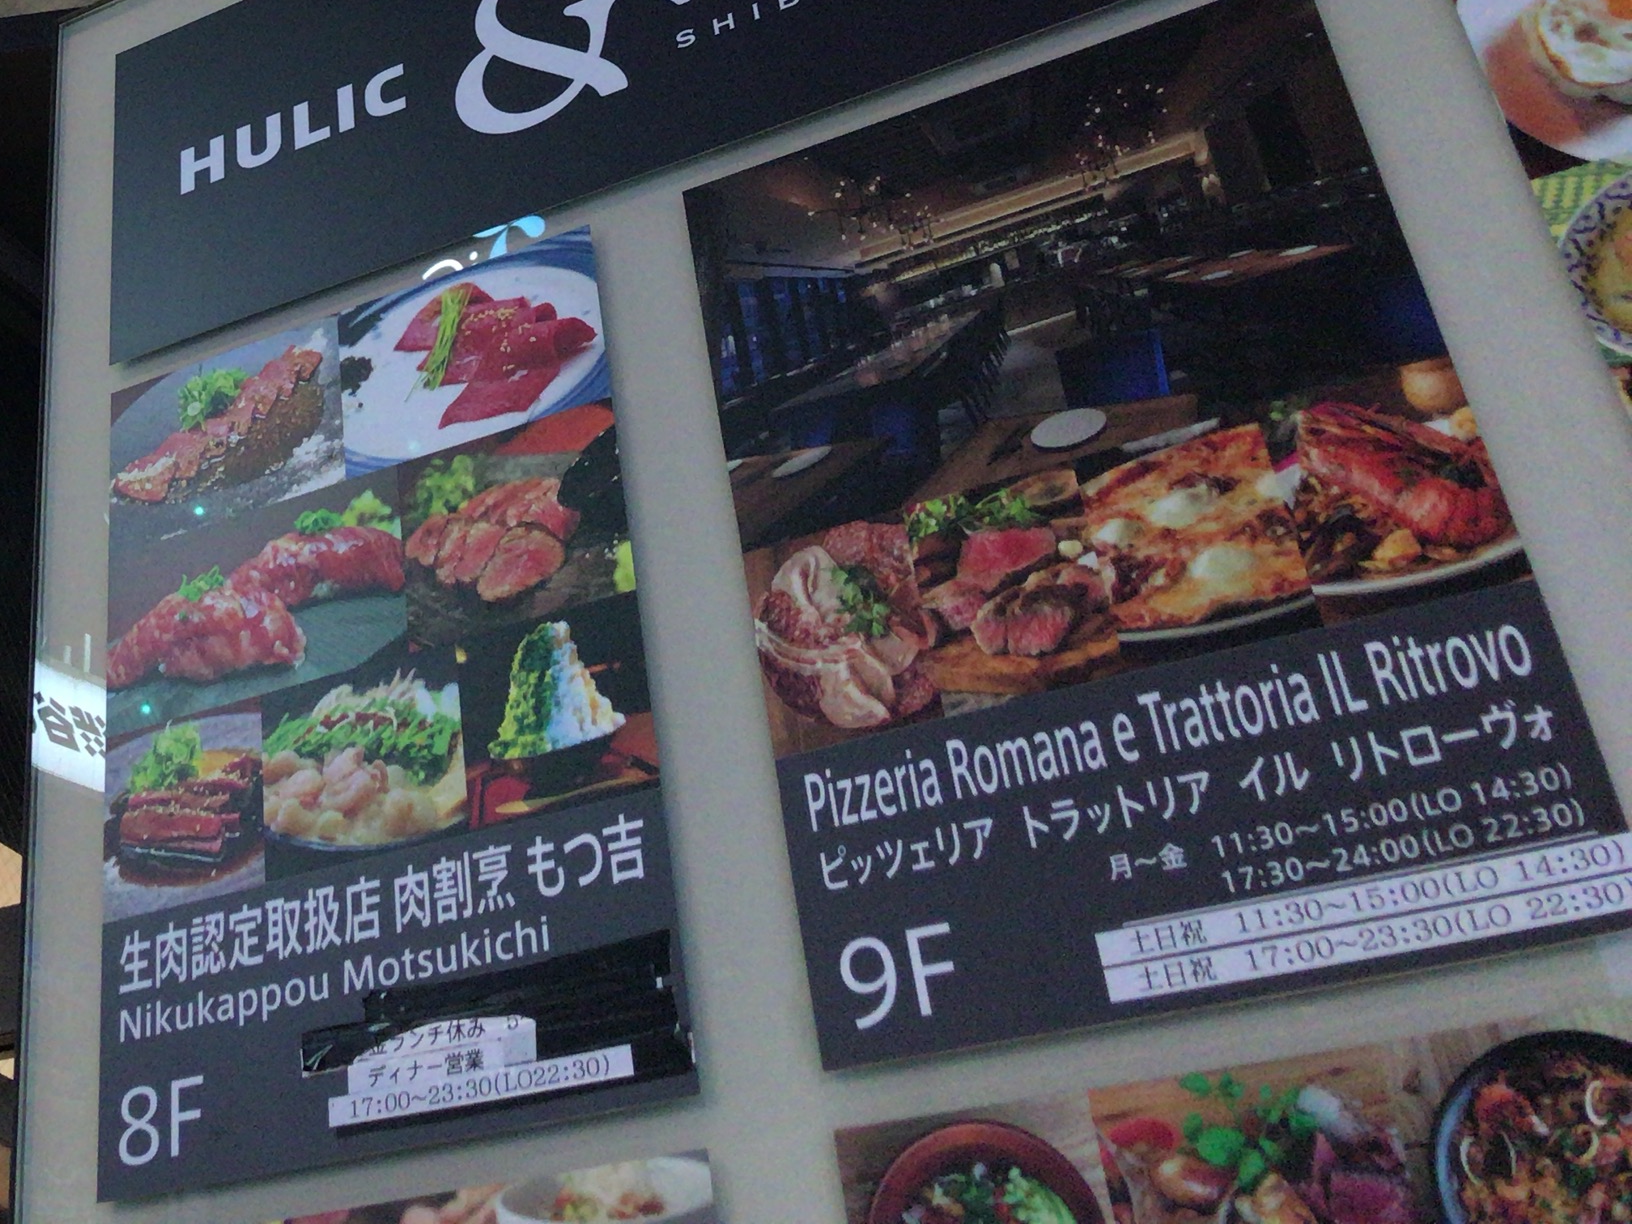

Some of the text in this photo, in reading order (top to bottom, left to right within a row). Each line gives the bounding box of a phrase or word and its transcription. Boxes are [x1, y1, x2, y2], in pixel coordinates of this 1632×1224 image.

[179, 63, 406, 196] HULIC
[803, 623, 1533, 832] Pizzeria Romana e Trattoria IL Ritrovo
[820, 699, 1554, 892] ピッツェリア トラットリア イル リトローヴォ
[118, 814, 645, 995] 生肉認定取扱店 肉割烹 もつ吉
[1129, 919, 1209, 956] 土日祝
[118, 914, 550, 1043] Nikukappou Motsukichi
[837, 921, 956, 1031] 9F
[1137, 956, 1218, 993] 土日祝
[118, 1075, 205, 1166] 8F
[368, 1048, 485, 1088] ディナー営業
